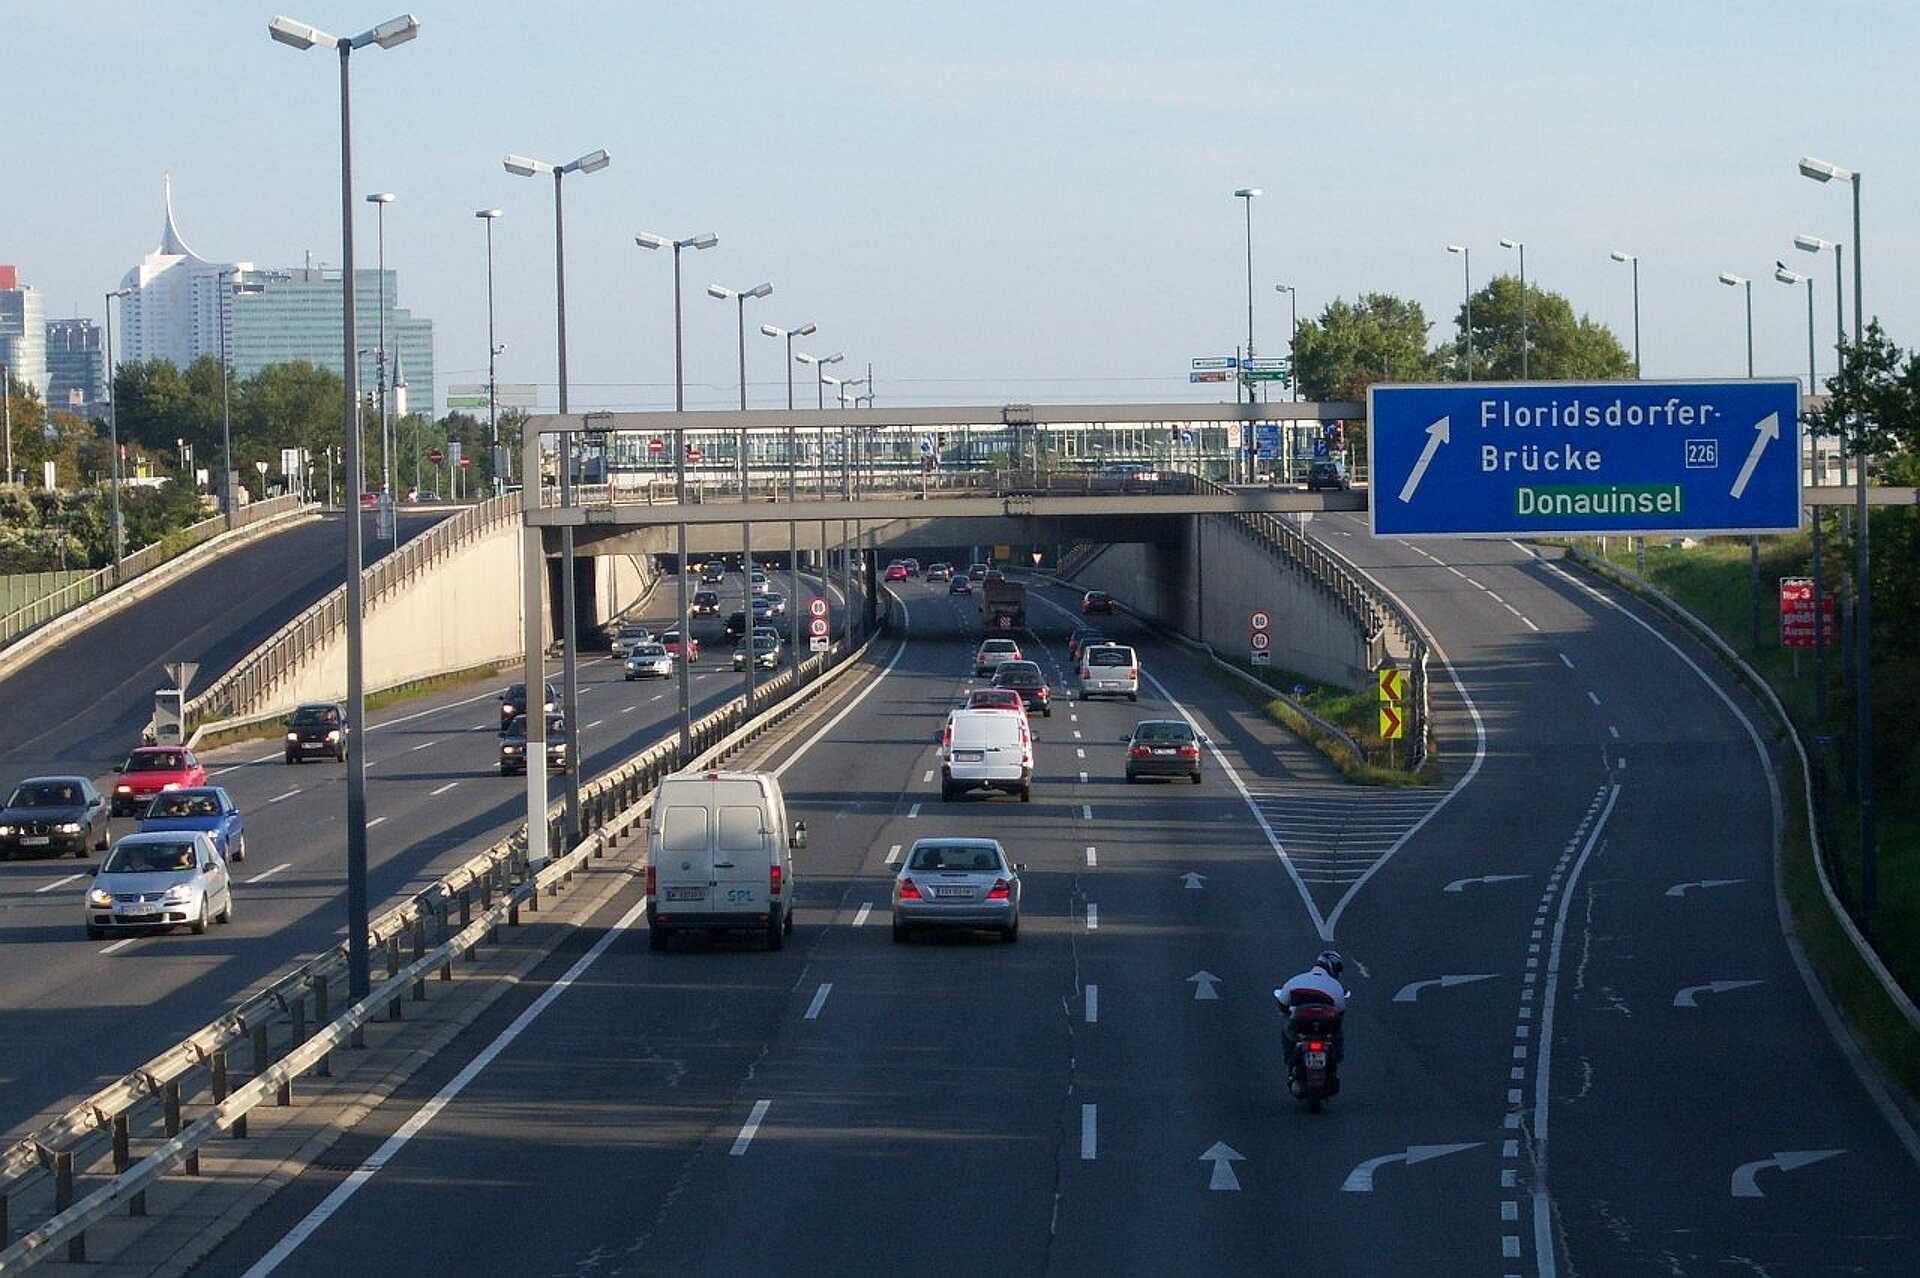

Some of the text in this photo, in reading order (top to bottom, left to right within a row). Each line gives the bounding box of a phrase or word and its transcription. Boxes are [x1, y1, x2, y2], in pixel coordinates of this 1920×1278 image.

[1482, 443, 1601, 471] Brücke
[1688, 445, 1715, 462] 226
[1518, 485, 1681, 514] Donauinsel
